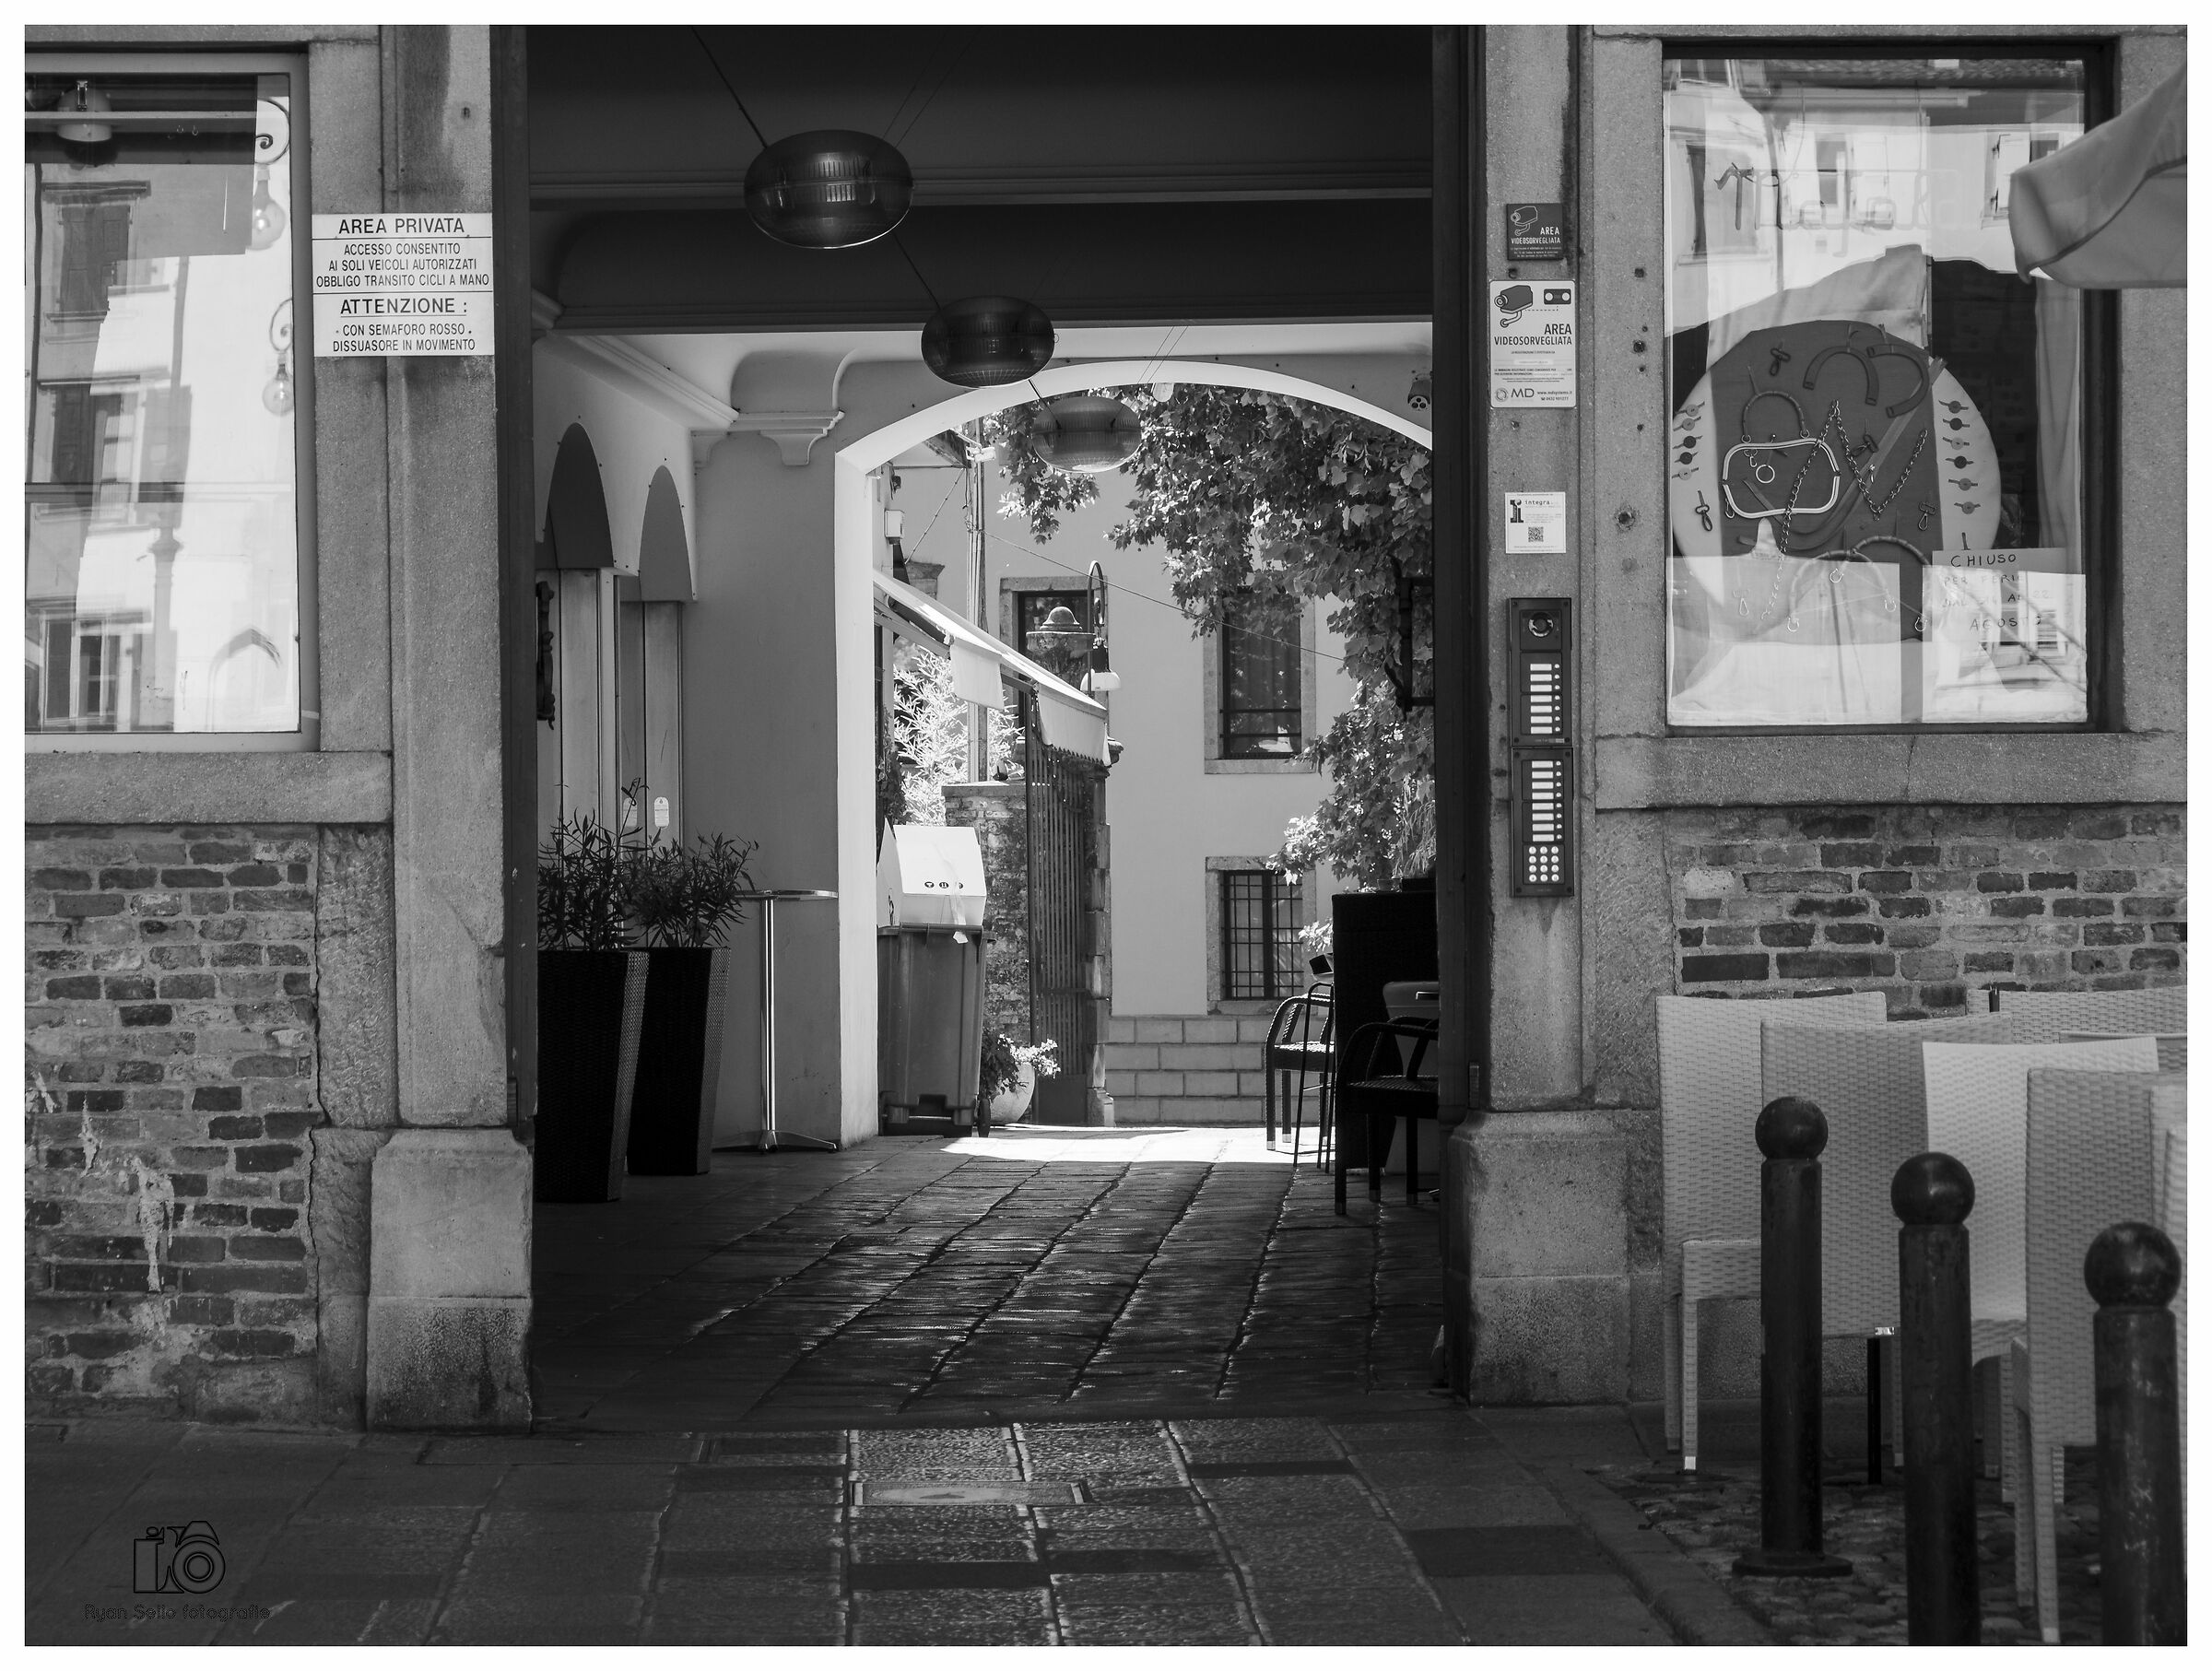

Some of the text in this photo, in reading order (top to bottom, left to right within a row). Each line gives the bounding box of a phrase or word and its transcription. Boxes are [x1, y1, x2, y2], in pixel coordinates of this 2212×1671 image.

[338, 218, 465, 234] AREA PRIVATA
[1540, 227, 1559, 235] AREA
[344, 243, 460, 254] ACCESSO CONSENTITO
[329, 259, 477, 271] AI SOLI VEICOLI AUTORIZZATI
[316, 274, 488, 287] OBBLIGO TRANSITO CICLI A MANO
[341, 299, 454, 313] ATTENZIONE
[343, 324, 465, 335] CON SEMAFORO ROSSO
[1545, 324, 1571, 335] AREA
[333, 339, 475, 351] DISSUASORE IN MOVIMENTO
[1494, 336, 1572, 345] VIDEOSORVEGLIATA
[1512, 388, 1535, 397] MD
[1951, 554, 2017, 567] CHIUSO
